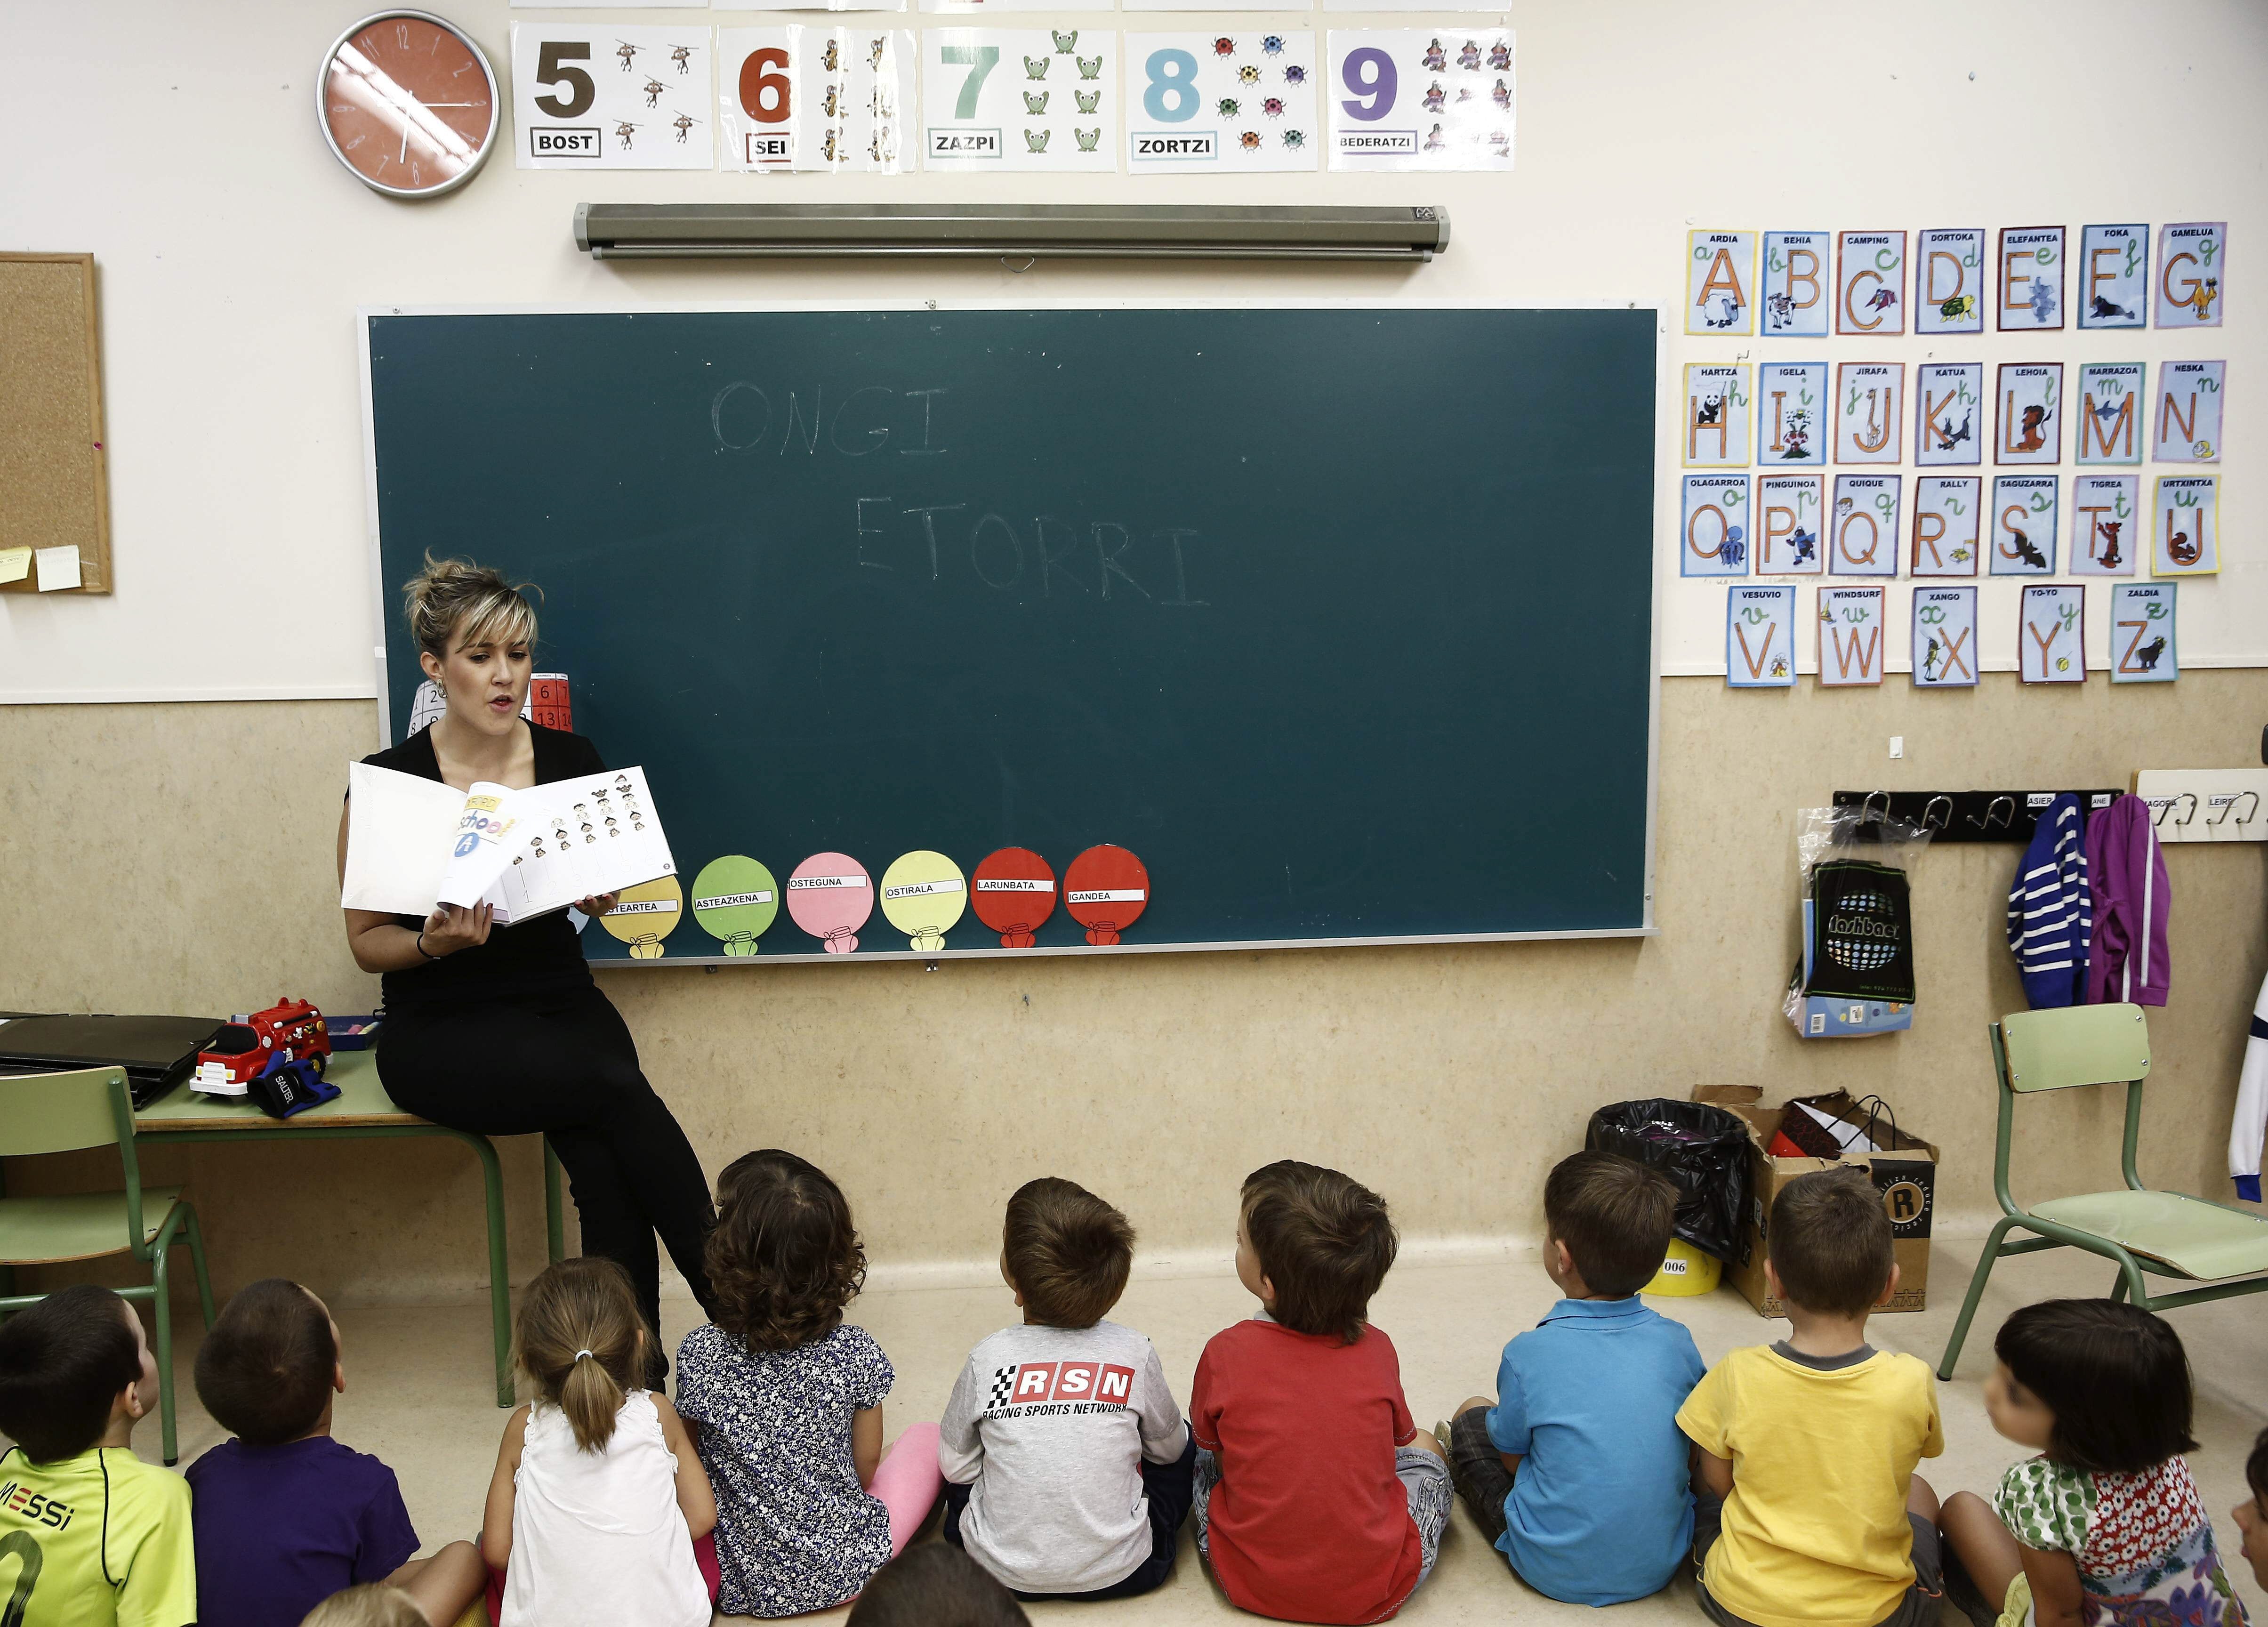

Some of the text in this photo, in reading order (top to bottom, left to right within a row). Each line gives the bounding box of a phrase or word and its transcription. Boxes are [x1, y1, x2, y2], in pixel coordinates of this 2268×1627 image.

[362, 36, 379, 59] 11
[397, 25, 409, 49] 12
[432, 34, 440, 56] 1
[453, 63, 472, 78] 2
[534, 42, 595, 118] 5
[941, 46, 999, 119] 7
[739, 48, 791, 123] 6
[1143, 48, 1200, 122] 8
[1342, 48, 1397, 121] 9
[346, 135, 365, 149] 8
[539, 136, 593, 149] BOST
[755, 141, 786, 154] SEI
[936, 137, 994, 150] ZAZPI
[1139, 140, 1210, 153] ZORTZI
[1341, 138, 1409, 146] BEDERATZI
[377, 155, 389, 176] 7
[413, 161, 419, 185] 6
[1710, 235, 1737, 243] ARDIA
[1784, 236, 1811, 244] BEHIA
[1848, 237, 1889, 245] CAMPING
[1931, 234, 1973, 242] DORTOKA
[2007, 234, 2057, 244] ELEFANTEA
[2171, 229, 2213, 237] GAMELUA
[1694, 247, 1713, 260] a
[1768, 247, 1786, 273] b
[1962, 243, 1981, 267] d
[2036, 247, 2057, 266] e
[2199, 239, 2219, 266] g
[1697, 249, 1746, 306] A
[1787, 250, 1819, 308] B
[1927, 252, 1963, 306] D
[2005, 252, 2034, 309] E
[2090, 249, 2121, 307] F
[2163, 253, 2202, 307] G
[1846, 271, 1883, 330] C
[2016, 368, 2048, 376] LEHOIA
[2089, 366, 2138, 375] MARRAZOA
[1729, 380, 1748, 407] h
[1799, 378, 1812, 405] i
[1847, 380, 1862, 415] j
[1958, 380, 1977, 405] k
[2045, 377, 2056, 406] l
[2098, 379, 2123, 396] m
[2197, 378, 2220, 393] n
[712, 381, 948, 456] ONGI
[1690, 396, 1727, 459] H
[1769, 392, 1786, 451] I
[1853, 388, 1890, 452] J
[1924, 389, 1956, 452] K
[2005, 391, 2035, 453] L
[2082, 392, 2134, 458] M
[2162, 393, 2196, 443] N
[2163, 480, 2212, 488] URTXINTXA
[1875, 494, 1895, 523] q
[2115, 491, 2131, 518] t
[2174, 491, 2198, 507] u
[1689, 504, 1727, 558] O
[1765, 507, 1795, 563] P
[1840, 512, 1877, 565] Q
[1914, 513, 1945, 568] R
[1999, 505, 2027, 559] S
[2078, 507, 2111, 558] T
[2167, 508, 2203, 565] U
[857, 497, 1210, 605] ETORRI
[1833, 591, 1881, 599] WINDSURF
[2058, 603, 2080, 632] y
[1734, 622, 1776, 679] V
[1832, 627, 1878, 679] W
[1938, 627, 1971, 679] X
[2027, 621, 2061, 678] Y
[2117, 621, 2148, 673] Z
[430, 690, 437, 703] 2
[540, 685, 567, 699] 6 7
[410, 723, 416, 735] 8
[538, 712, 555, 725] 13
[456, 836, 473, 852] A
[790, 878, 842, 887] OSTEGUNA
[887, 885, 933, 897] OSTIRALA
[978, 881, 1034, 889] LARUNBATA
[523, 890, 533, 903] 1
[697, 894, 758, 908] ASTEAZKENA
[1069, 893, 1110, 901] IGANDEA
[275, 1075, 294, 1104] SALTER
[1892, 1189, 1914, 1218] R
[1665, 1262, 1685, 1272] 006
[1018, 1369, 1129, 1398] RSN
[983, 1403, 1127, 1420] RACING SPORTS NETWORK
